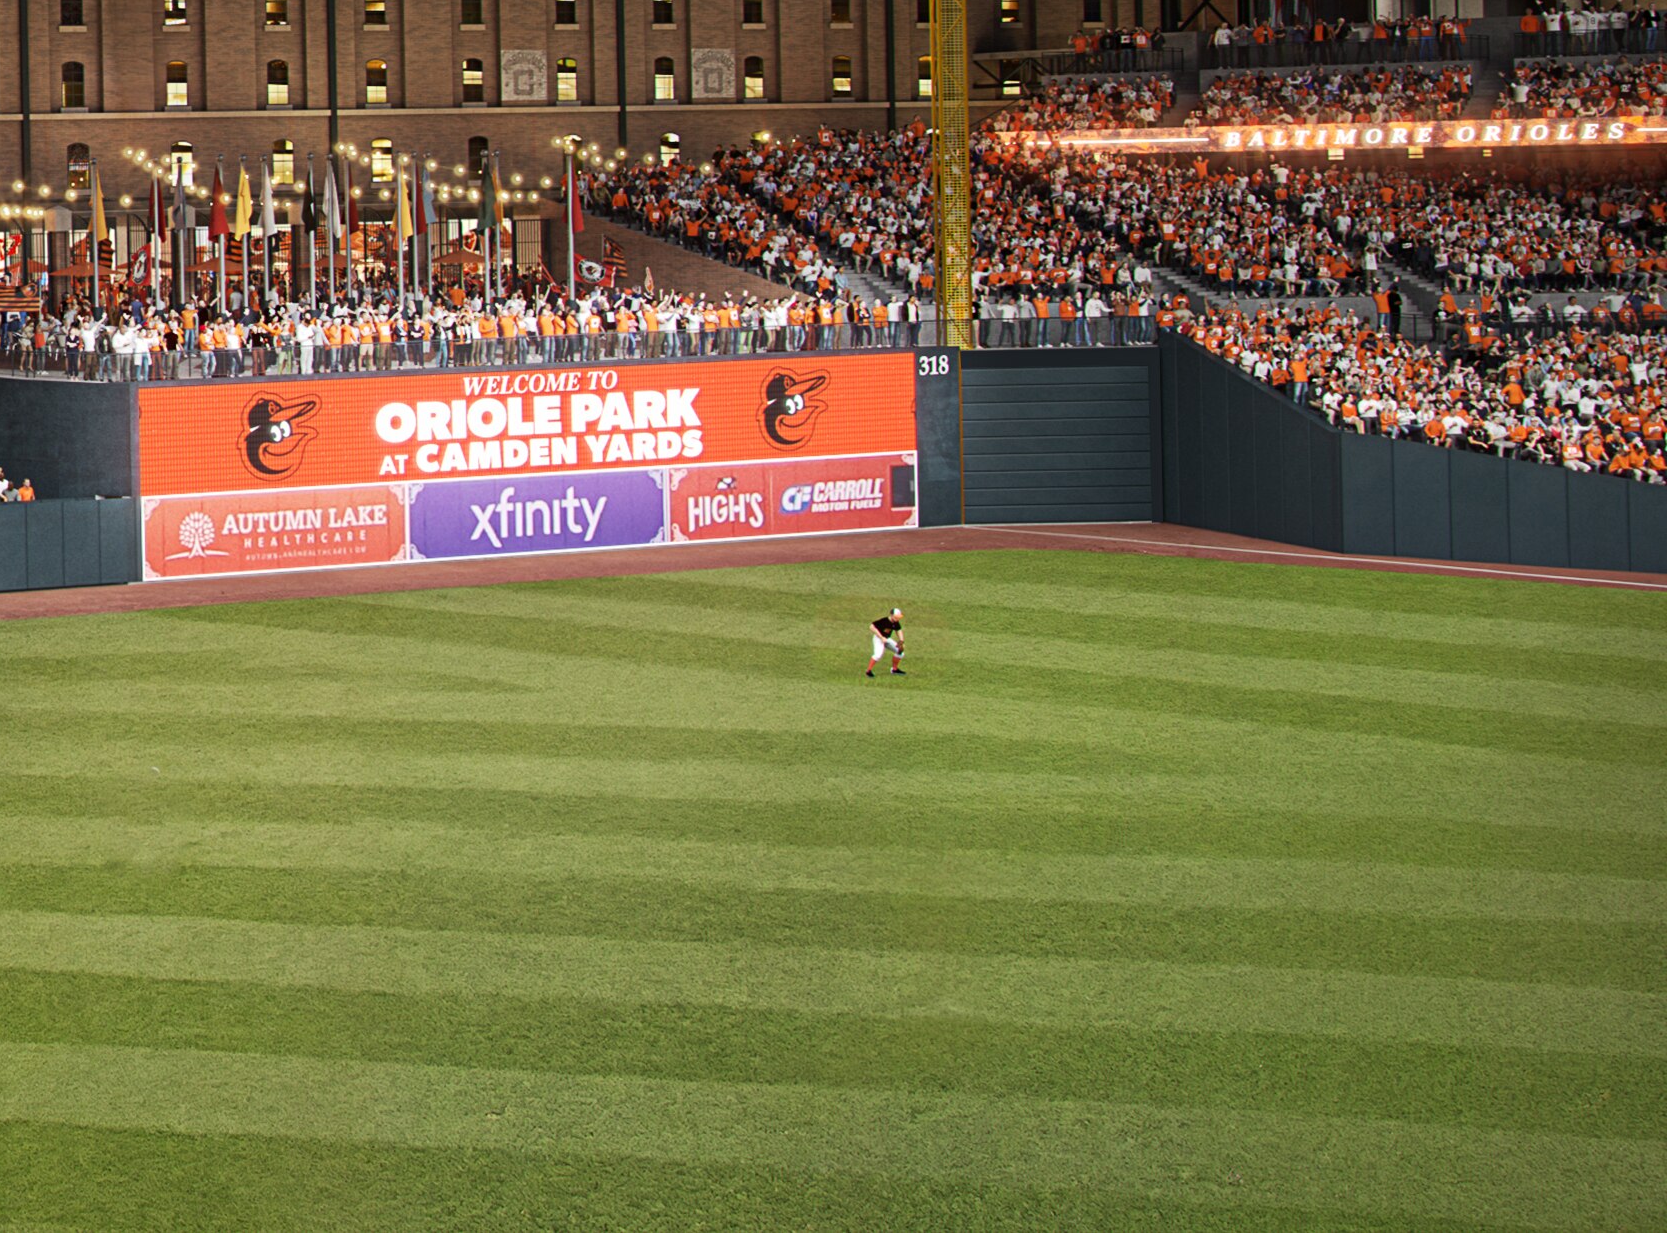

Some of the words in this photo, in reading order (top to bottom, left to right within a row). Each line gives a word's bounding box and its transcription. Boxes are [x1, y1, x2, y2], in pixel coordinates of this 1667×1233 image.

[1225, 126, 1433, 148] BALTIMORE
[1456, 122, 1624, 142] ORIOLES
[918, 354, 950, 376] 318
[463, 371, 581, 396] WELCOME
[588, 369, 618, 390] TO
[375, 396, 562, 444] ORIOLE
[571, 387, 702, 433] PARK
[379, 454, 409, 476] AT
[415, 436, 577, 474] CAMDEN
[584, 429, 703, 463] YARDS
[813, 477, 884, 503] CARROLL
[469, 486, 607, 549] xfinity
[687, 492, 765, 533] HIGH'S
[811, 501, 849, 513] MOTOR
[850, 498, 882, 511] FUELS
[222, 508, 325, 535] AUTUMN
[328, 504, 388, 529] LAKE
[244, 530, 366, 549] HEALTHCARE
